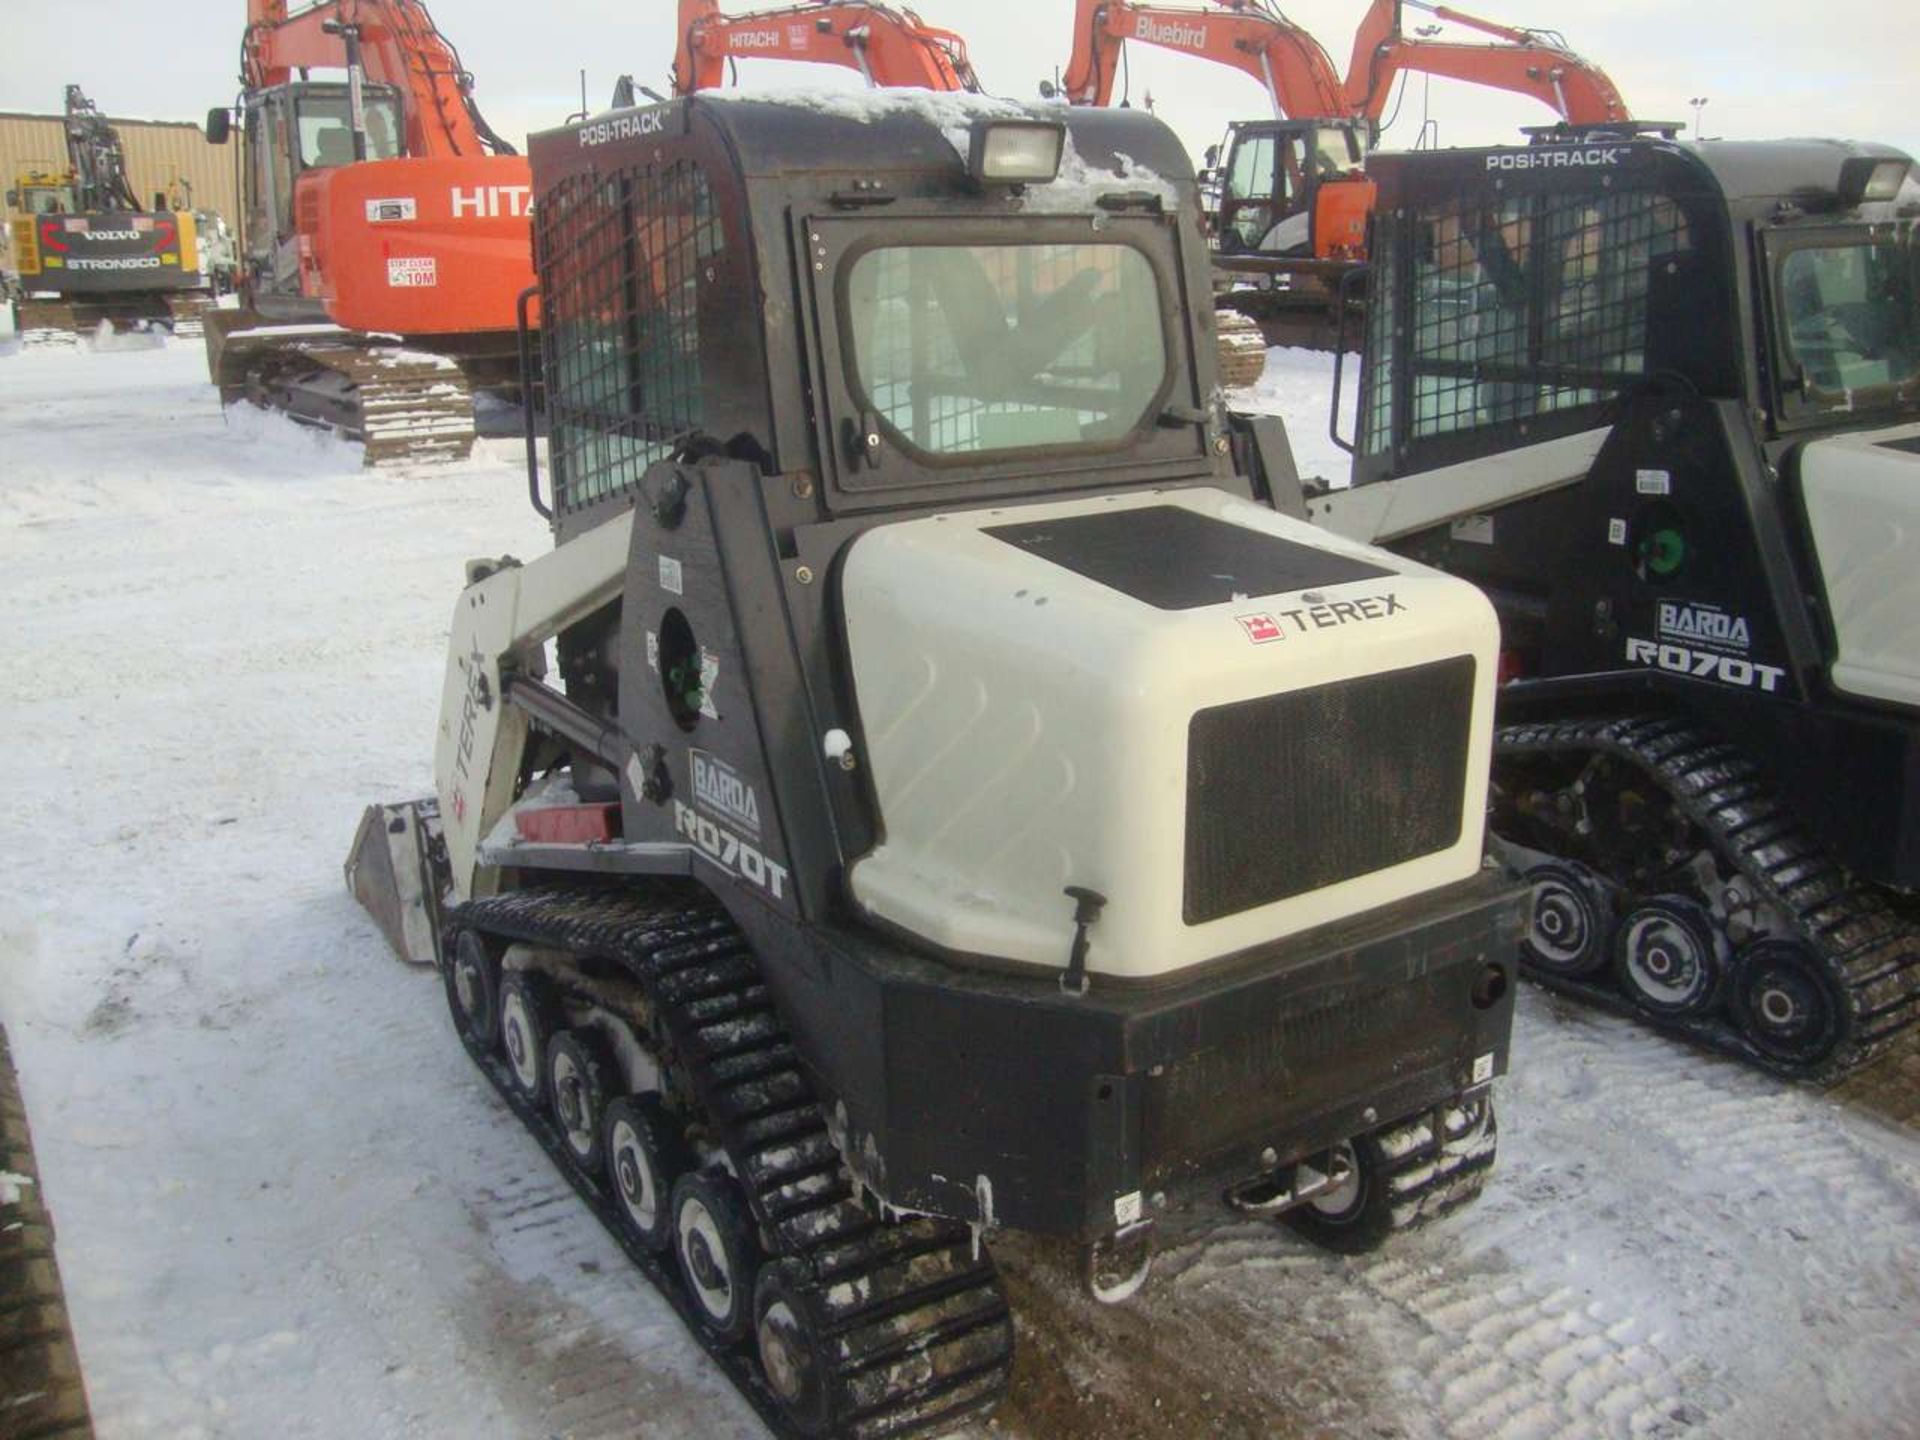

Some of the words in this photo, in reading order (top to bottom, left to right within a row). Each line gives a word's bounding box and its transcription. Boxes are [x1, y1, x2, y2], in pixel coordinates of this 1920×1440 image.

[729, 31, 779, 48] HITACHI
[1136, 15, 1207, 49] Bluebird
[579, 108, 663, 148] POSI-TRACK
[1486, 149, 1618, 170] POSI-TRACK
[84, 229, 141, 241] VOLVO
[66, 257, 161, 270] STRONGCO
[407, 272, 434, 285] 10M
[1280, 593, 1407, 632] TEREX
[1659, 603, 1749, 643] BARDA
[694, 756, 760, 825] BARDA
